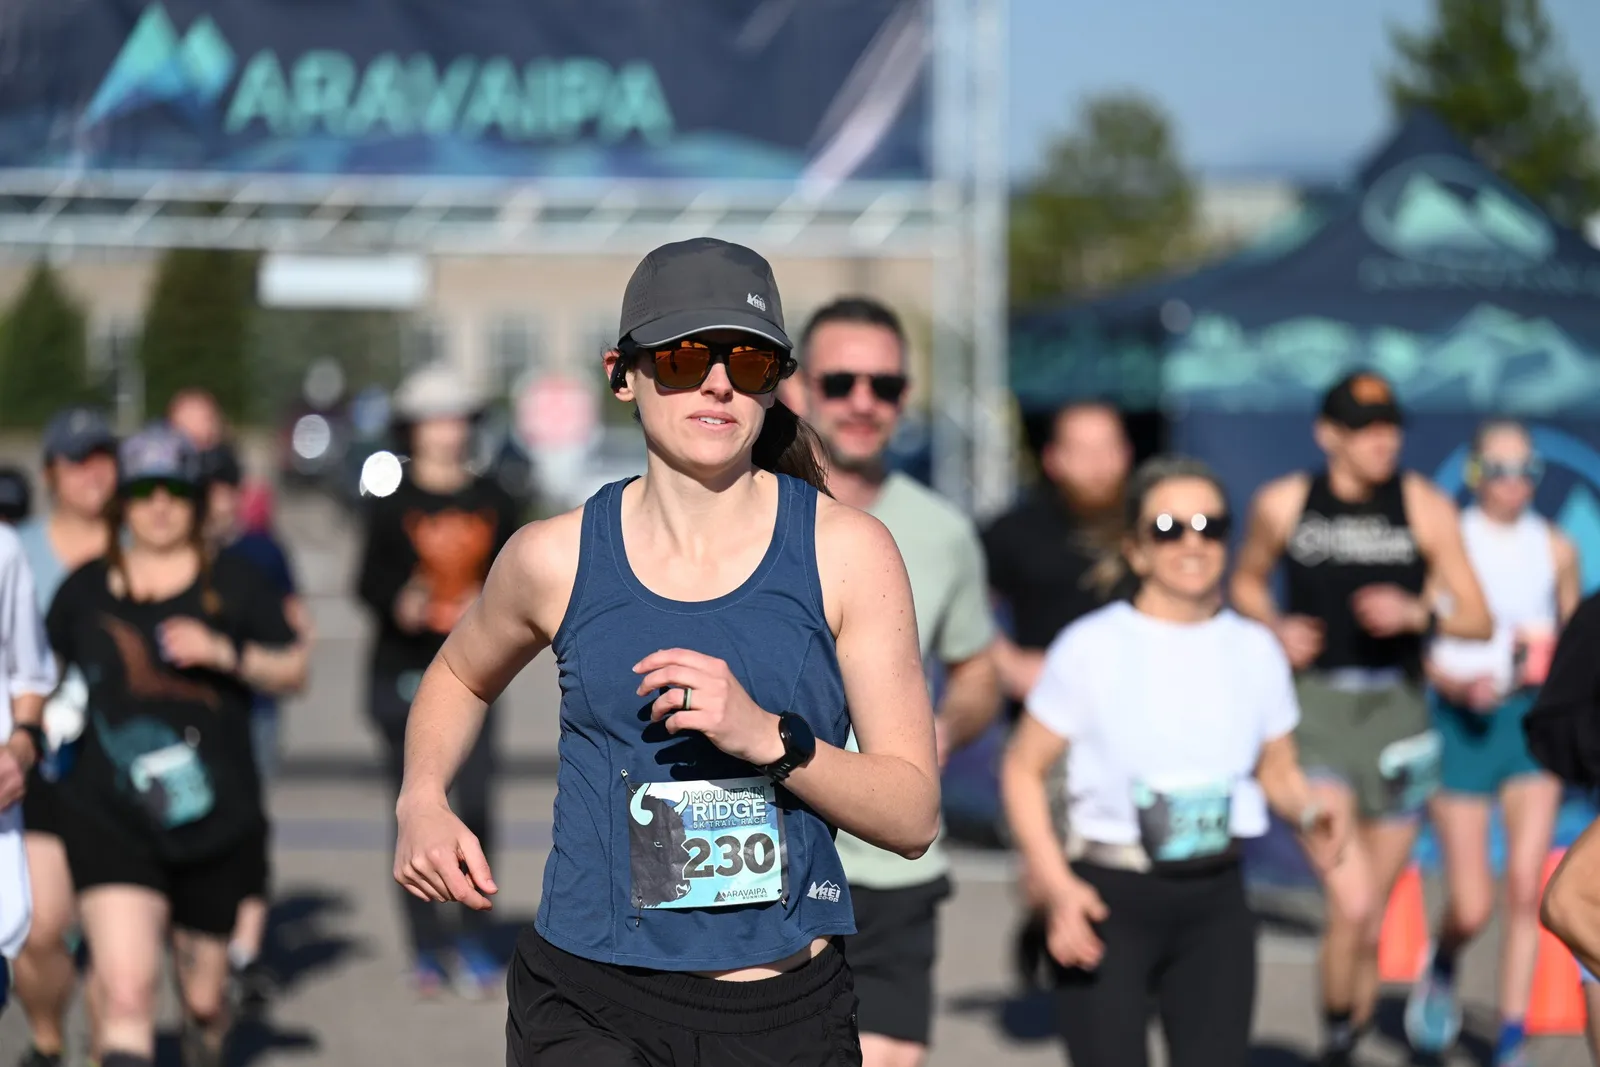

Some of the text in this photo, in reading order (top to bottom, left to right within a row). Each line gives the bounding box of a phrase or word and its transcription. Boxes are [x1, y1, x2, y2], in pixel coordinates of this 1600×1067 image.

[226, 50, 674, 142] ARAVAIPA
[691, 786, 765, 803] MOUNTAIN
[692, 798, 767, 822] RIDGE
[693, 817, 767, 829] 5K TRAIL RACE
[681, 833, 776, 879] 230
[726, 888, 768, 898] ARAVAIPA
[821, 887, 841, 899] REI
